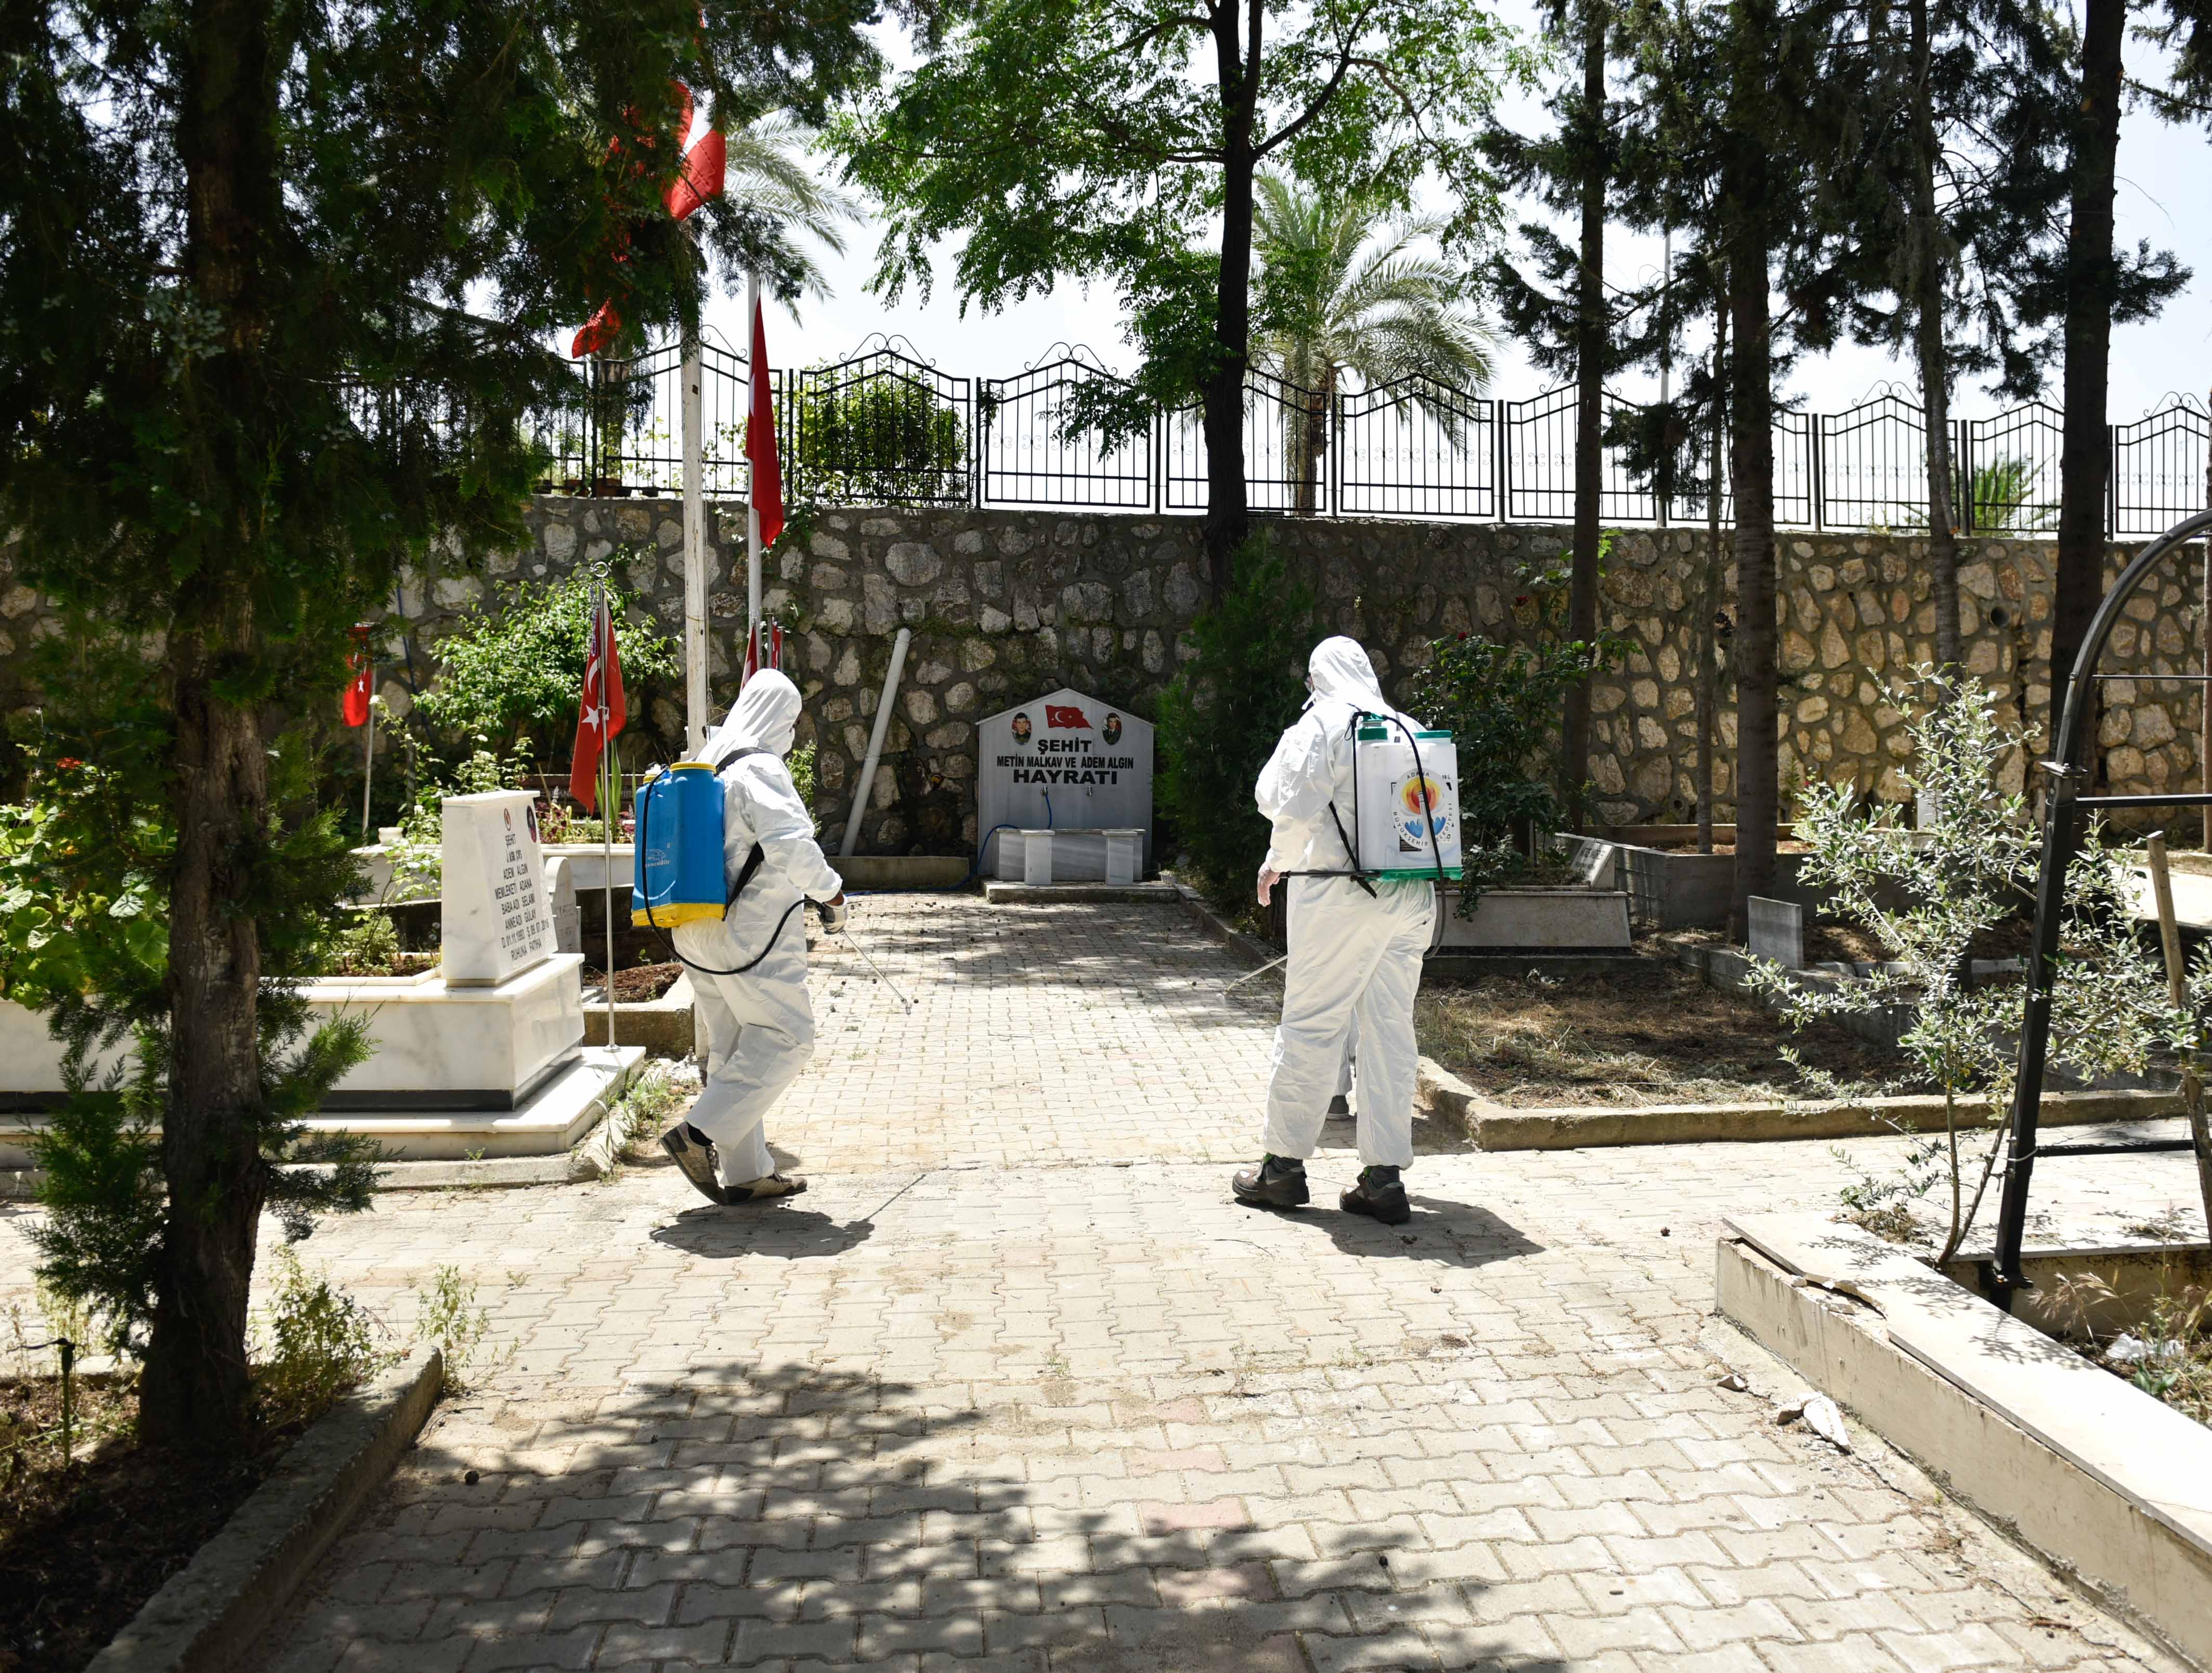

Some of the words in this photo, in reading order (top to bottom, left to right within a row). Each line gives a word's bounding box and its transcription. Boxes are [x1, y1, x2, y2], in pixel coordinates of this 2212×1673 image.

[1038, 737, 1091, 755] ŞEHİT
[997, 753, 1024, 767] METİN
[1027, 756, 1063, 768] MALKAV
[1065, 757, 1076, 768] VE
[1081, 757, 1105, 768] ADEM
[1108, 757, 1134, 769] ALGIN
[1013, 769, 1117, 785] HAYRATI
[1407, 771, 1429, 779] ADAA
[503, 867, 514, 880] ADEM
[517, 864, 528, 875] ALGIN
[519, 878, 532, 891] ADANA
